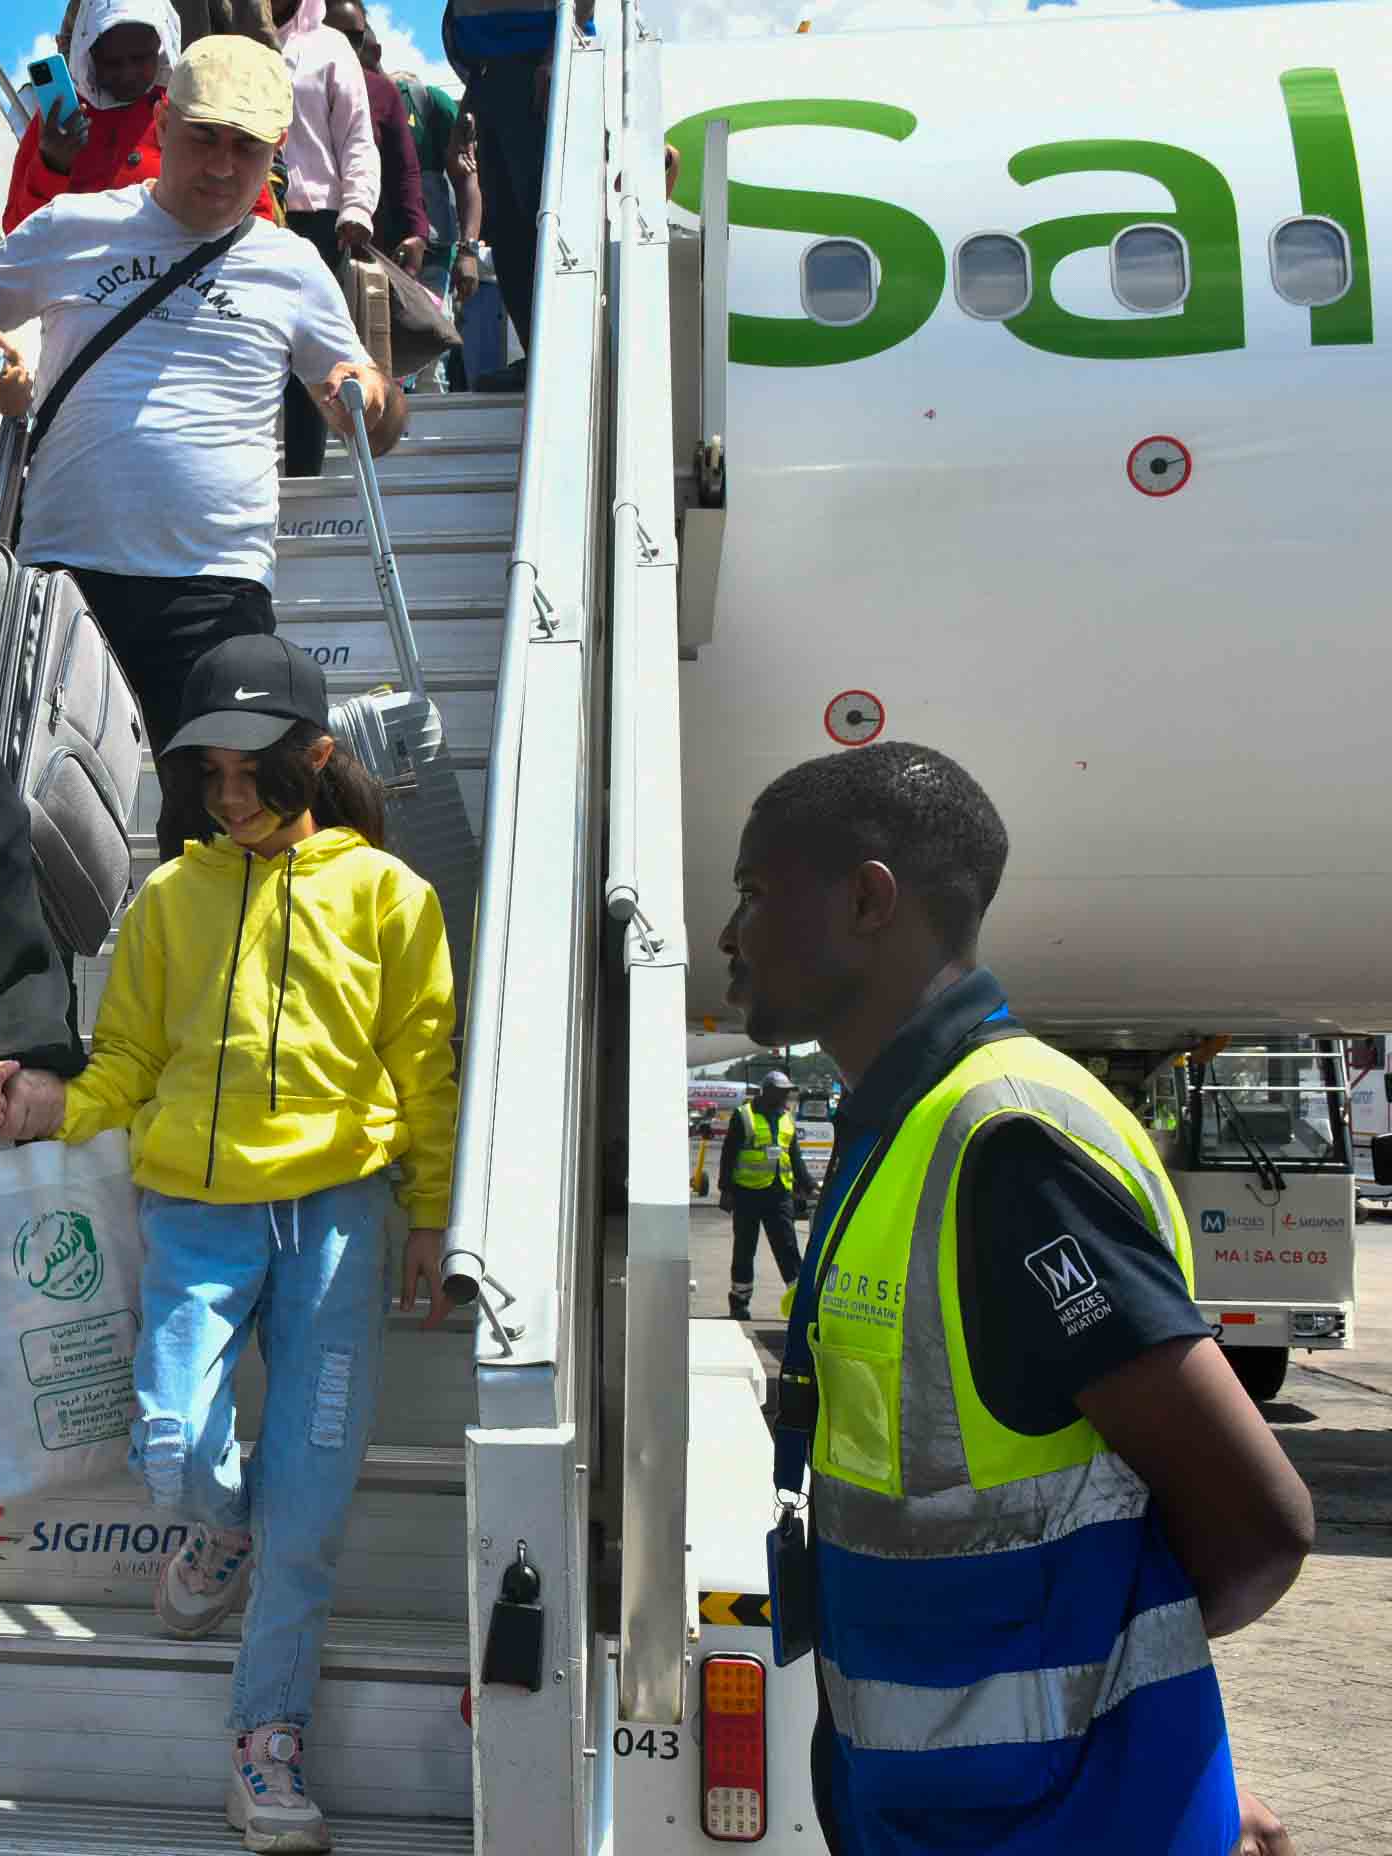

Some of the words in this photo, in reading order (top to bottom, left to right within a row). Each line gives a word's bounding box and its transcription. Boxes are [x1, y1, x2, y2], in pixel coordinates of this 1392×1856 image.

[664, 67, 1373, 368] Sal
[85, 255, 161, 304] LOCAL
[1215, 1250, 1240, 1262] MA
[1254, 1250, 1274, 1263] SA
[1308, 1251, 1328, 1264] 03
[1057, 1291, 1105, 1325] MENZIES
[1067, 1303, 1112, 1336] AVIATION
[613, 1727, 660, 1760] 043
